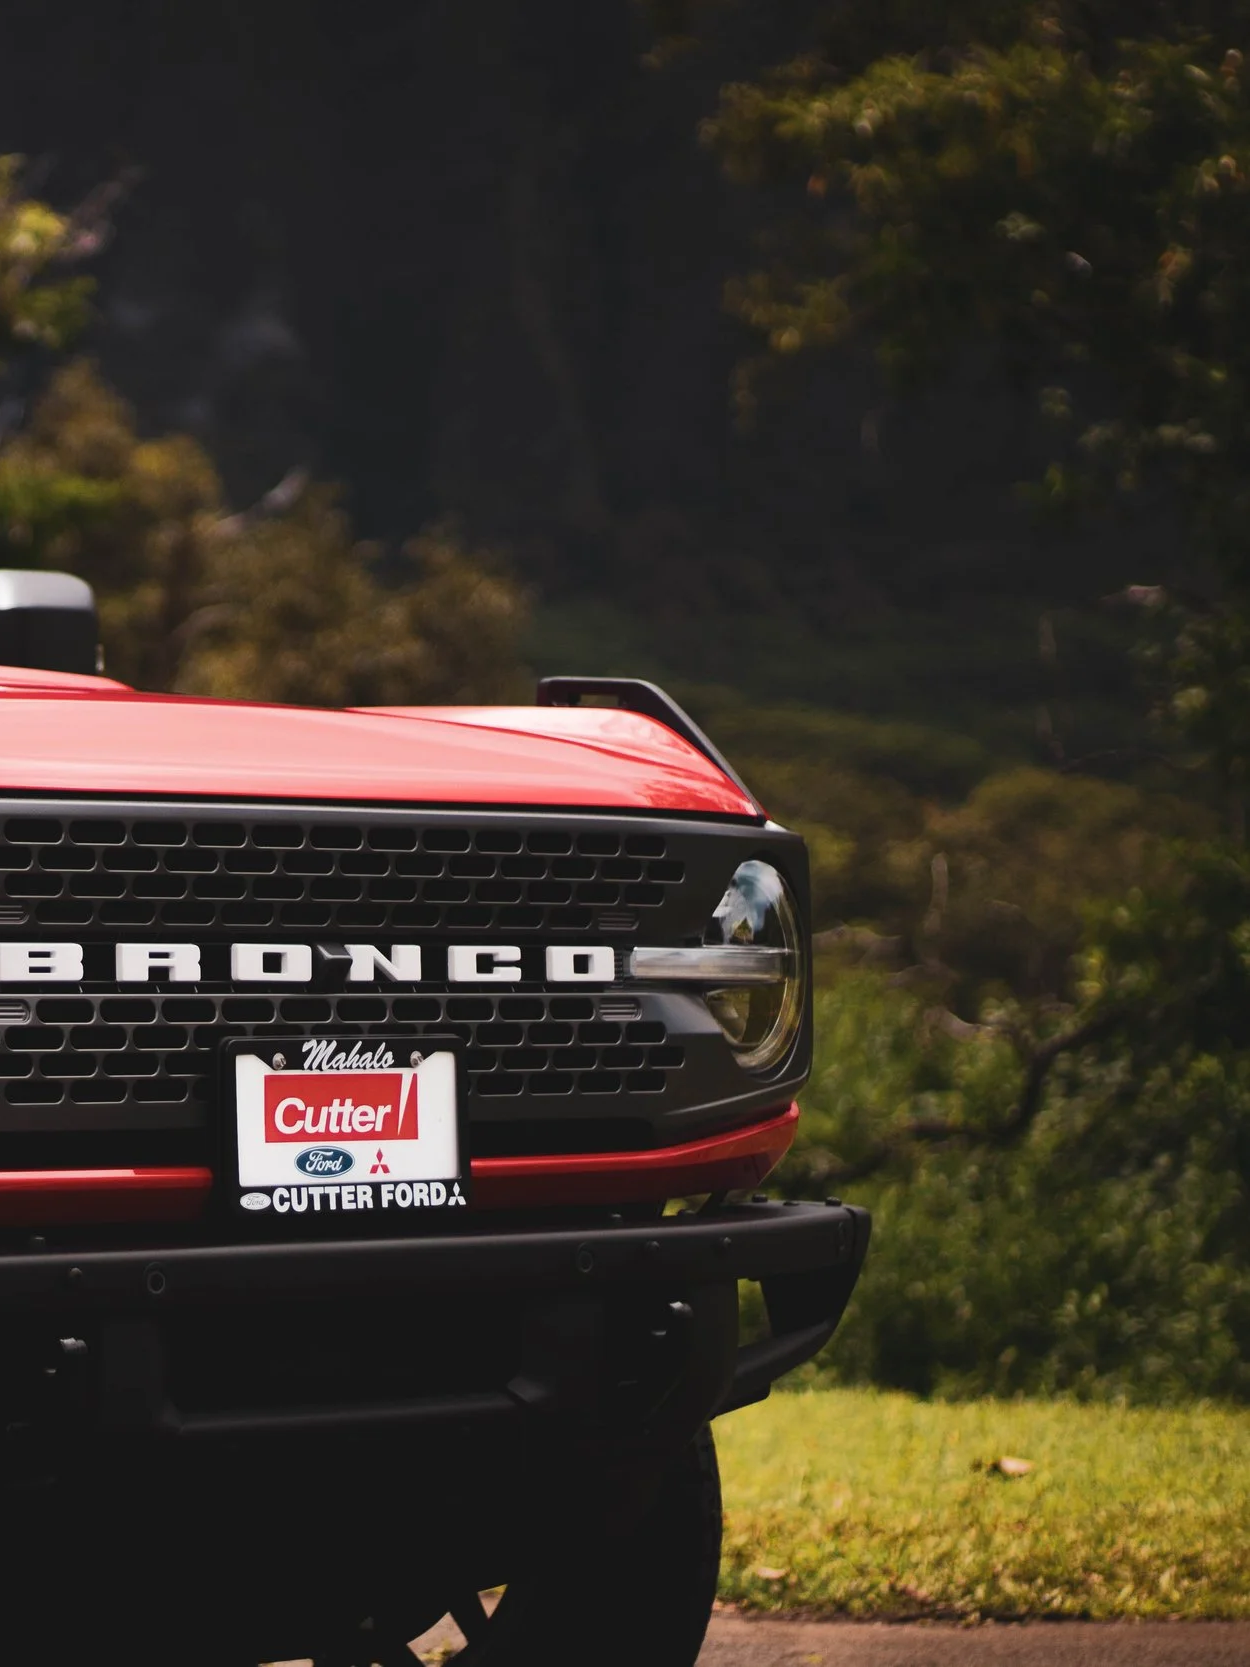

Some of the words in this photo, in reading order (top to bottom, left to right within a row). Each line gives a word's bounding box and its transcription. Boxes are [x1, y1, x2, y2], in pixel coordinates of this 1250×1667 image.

[302, 1039, 394, 1070] Mahalo
[274, 1097, 392, 1135] Cutter
[305, 1150, 344, 1172] Ford
[272, 1184, 373, 1213] CUTTER
[381, 1182, 447, 1208] FORD
